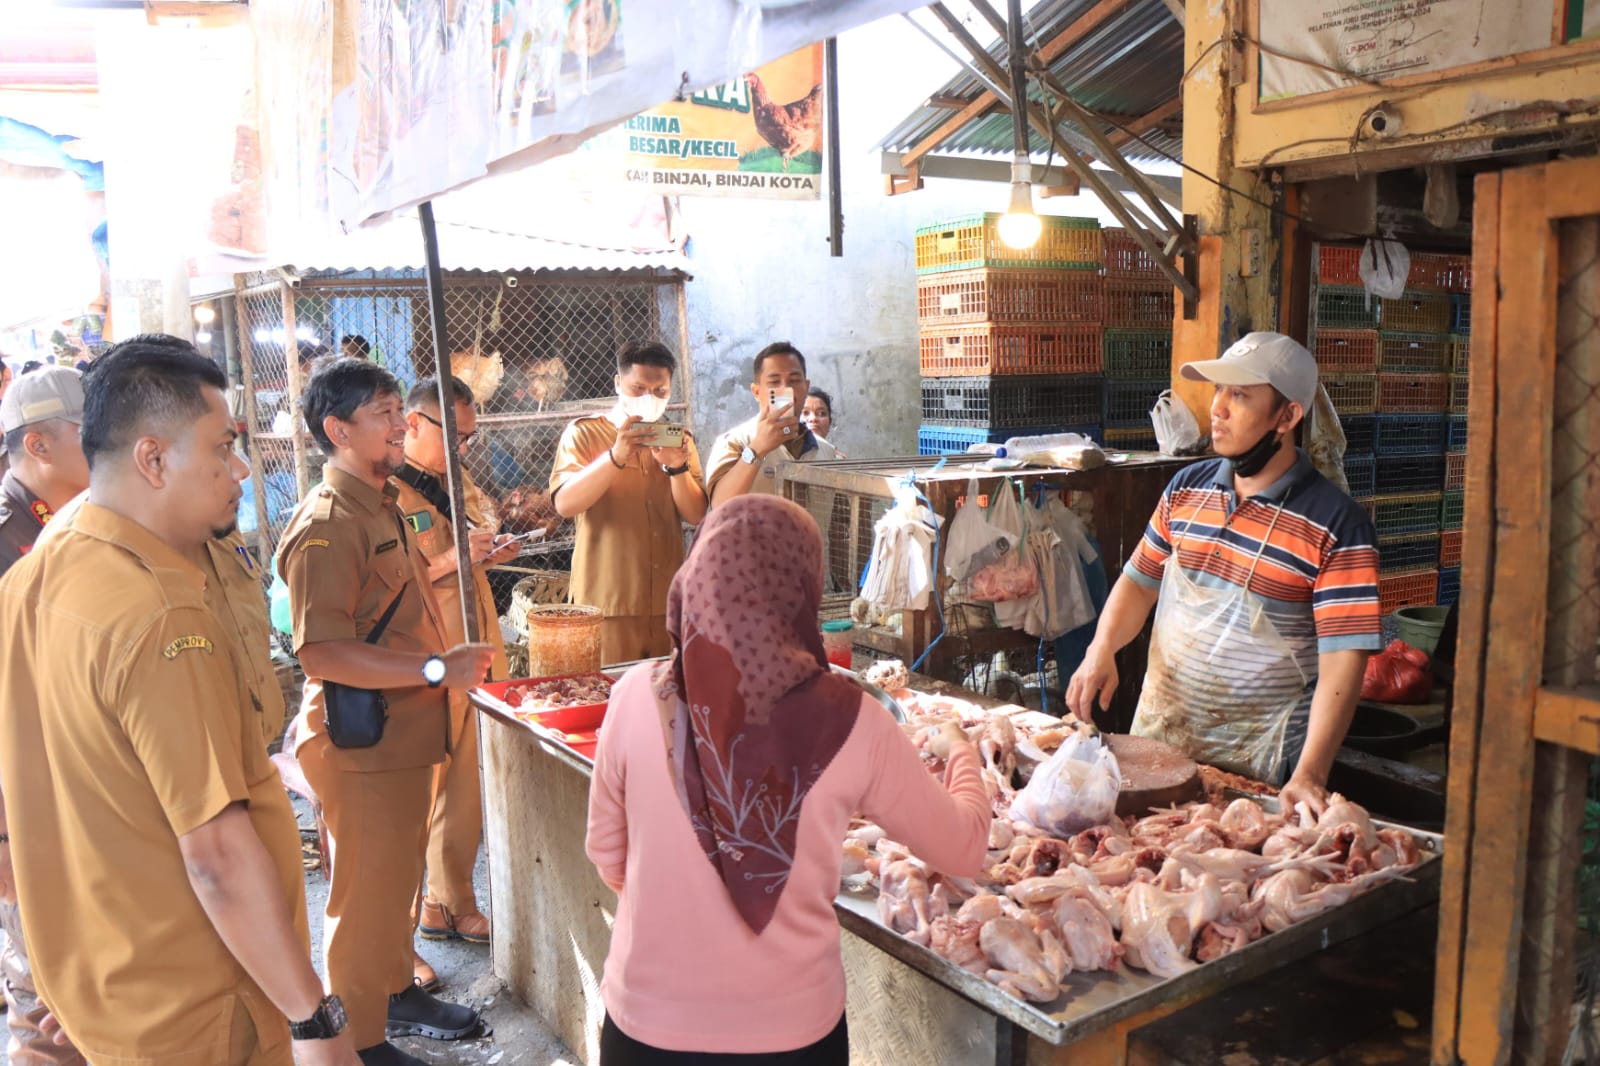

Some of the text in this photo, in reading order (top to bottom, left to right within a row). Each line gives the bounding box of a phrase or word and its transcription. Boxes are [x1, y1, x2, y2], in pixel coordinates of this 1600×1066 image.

[629, 136, 738, 158] BESAR/KECIL
[653, 172, 712, 187] BINJAI,
[716, 174, 765, 188] BINJAI
[769, 176, 814, 189] KOTA
